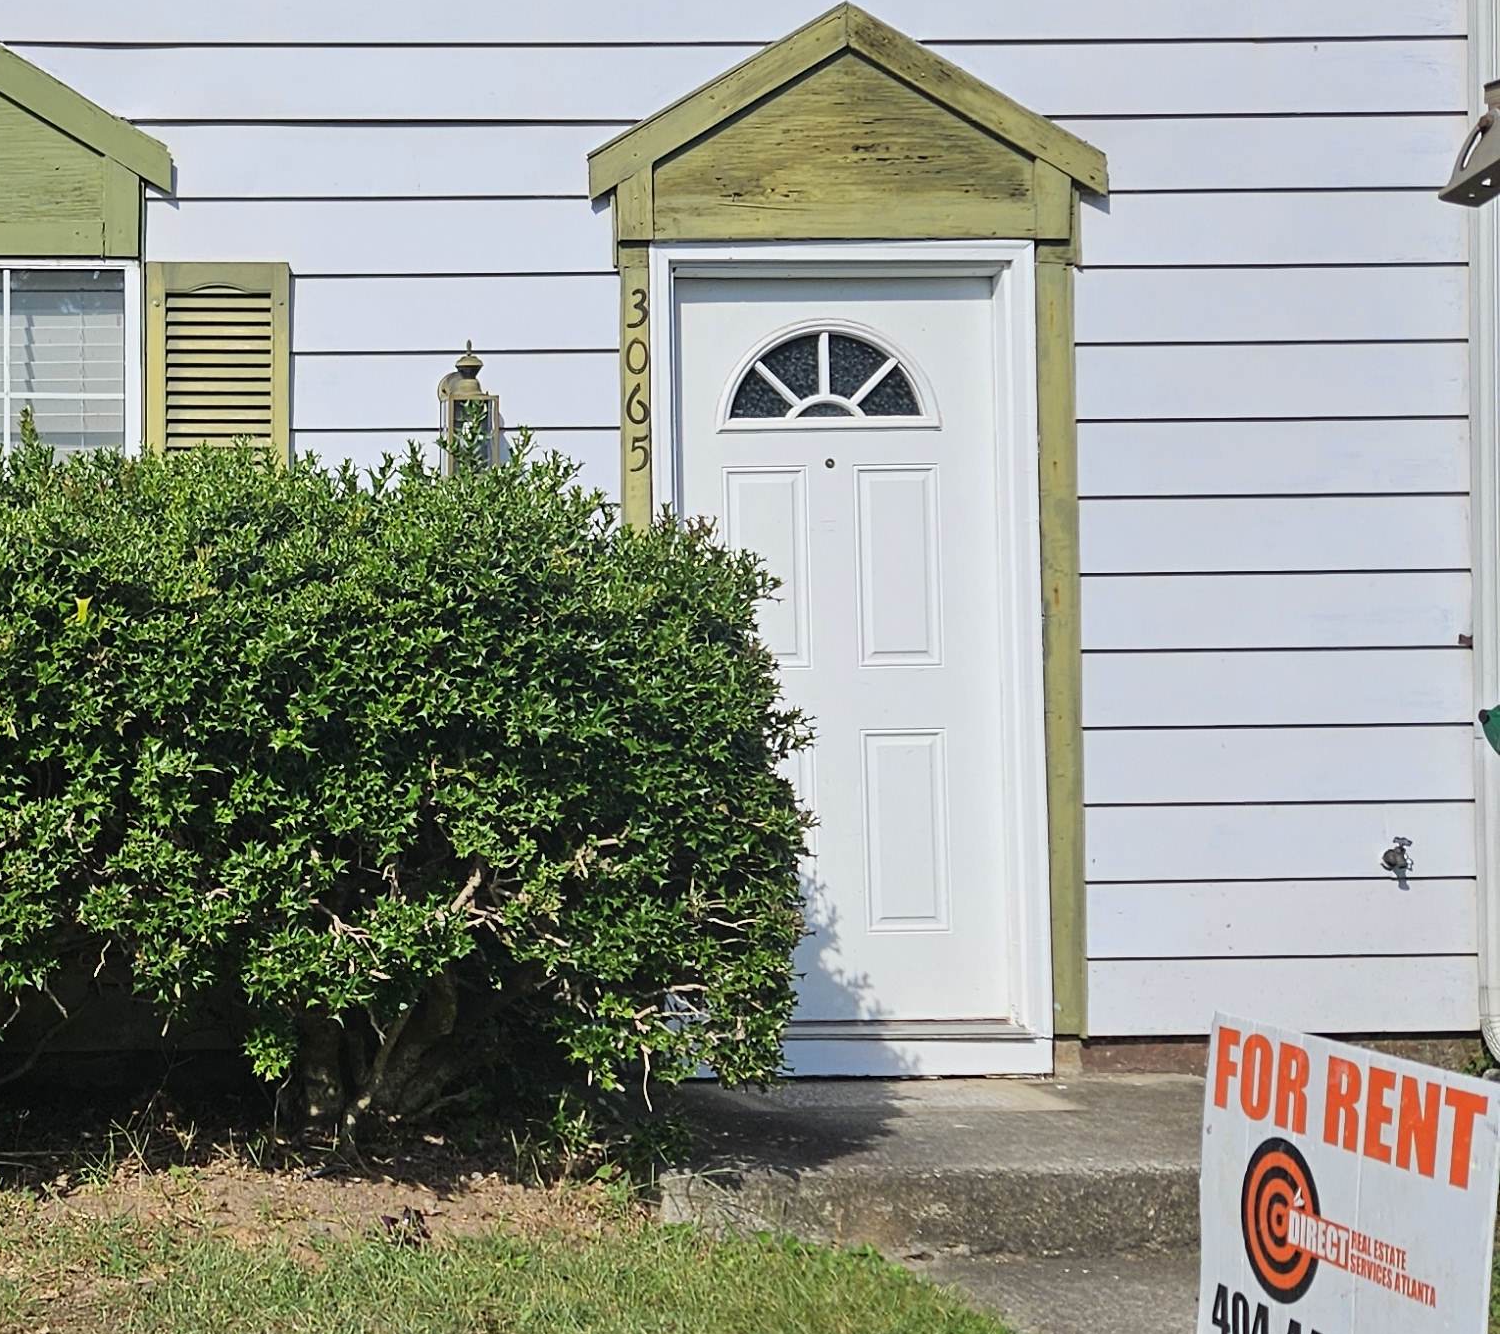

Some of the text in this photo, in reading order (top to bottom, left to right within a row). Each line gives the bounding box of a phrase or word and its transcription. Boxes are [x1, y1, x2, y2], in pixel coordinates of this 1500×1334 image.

[625, 287, 649, 472] 3065
[1213, 1025, 1489, 1190] FOR RENT
[1288, 1210, 1349, 1268] DIRECT
[1351, 1230, 1407, 1271] REAL ESTATE
[1350, 1253, 1436, 1308] SERVICES ATLANTA
